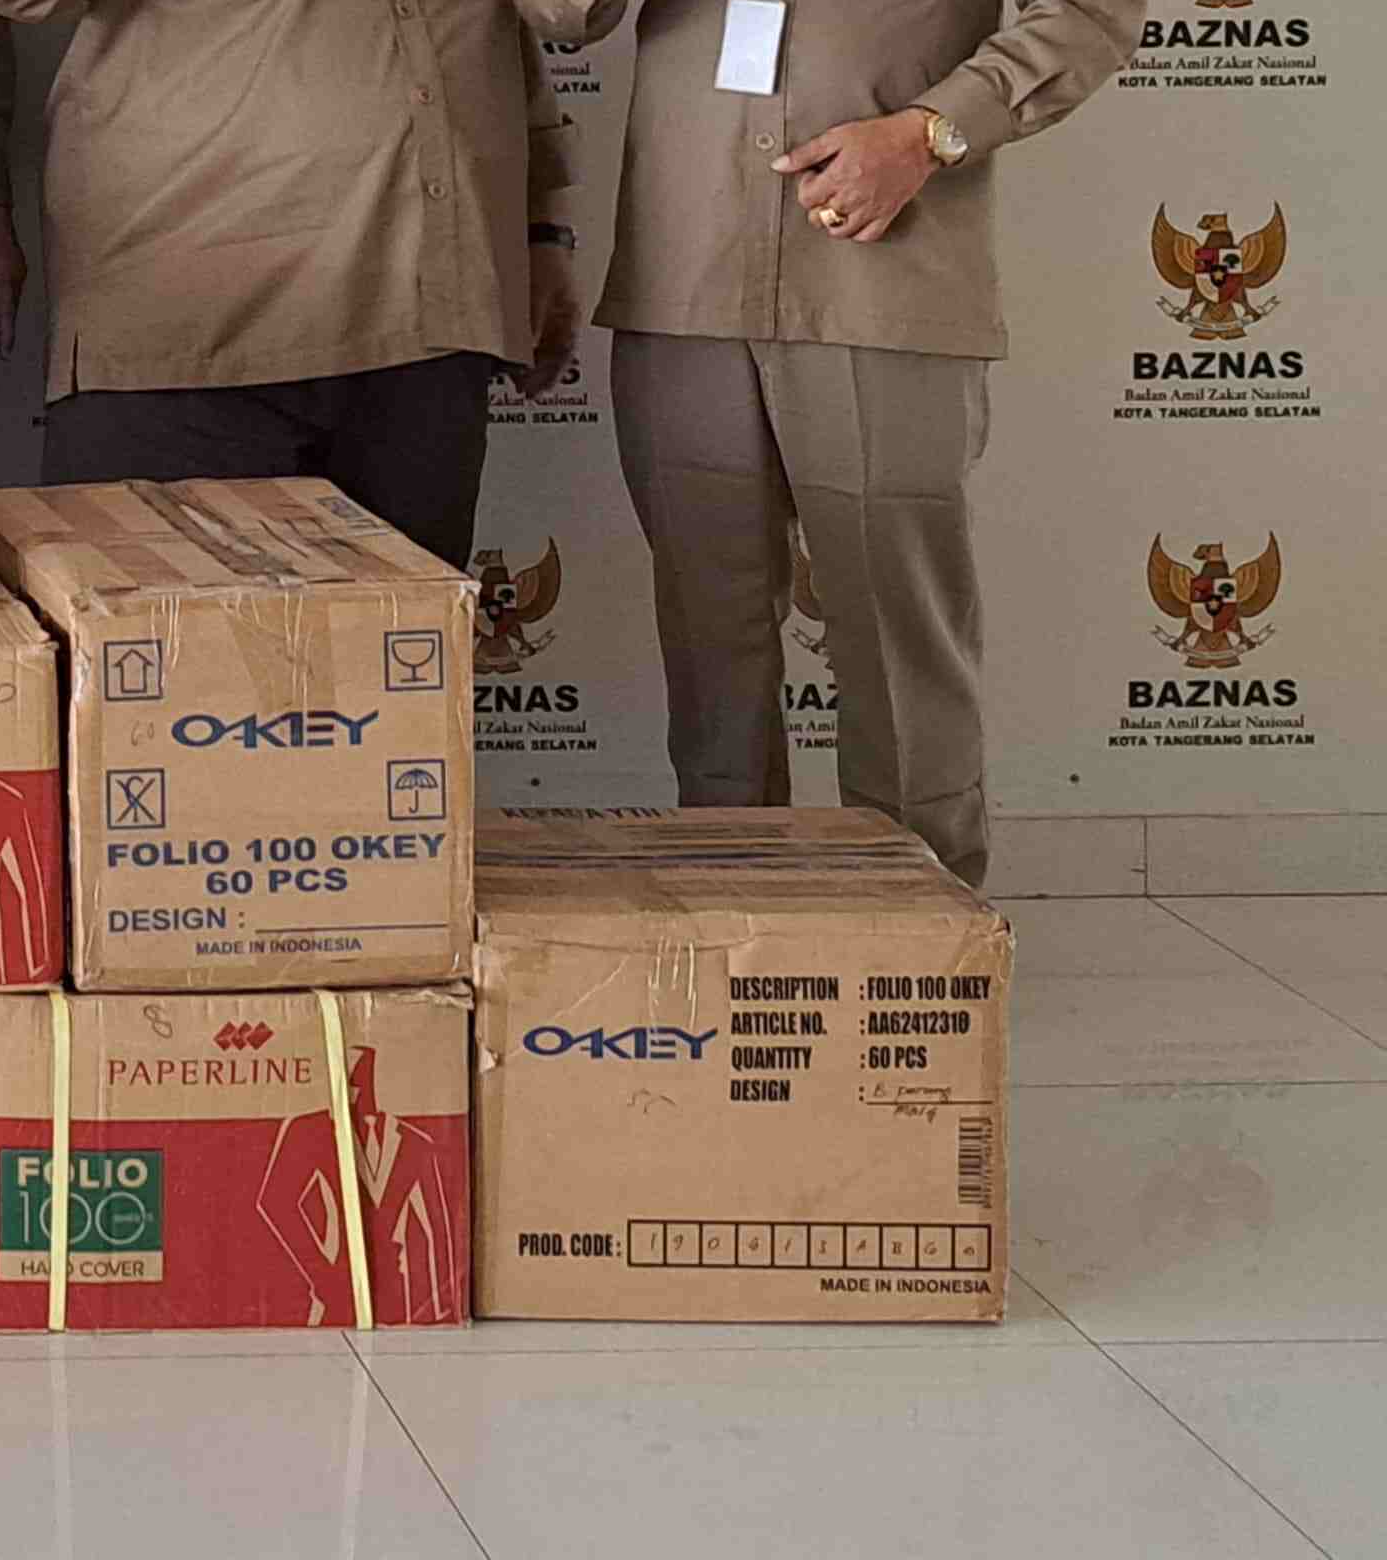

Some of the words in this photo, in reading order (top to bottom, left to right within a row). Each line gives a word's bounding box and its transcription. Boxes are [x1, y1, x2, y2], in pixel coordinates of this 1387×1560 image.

[1133, 351, 1303, 379] BAZNAS
[1125, 389, 1166, 401] Badan
[1171, 389, 1204, 400] Amil
[1208, 389, 1246, 400] Zakat
[1251, 387, 1310, 399] Nasional
[1114, 408, 1154, 419] KOTA
[1159, 407, 1248, 418] TANGERANG
[1255, 406, 1321, 417] SELATAN
[107, 839, 229, 867] FOLIO
[245, 837, 316, 864] 100
[331, 832, 447, 861] OKEY
[206, 870, 253, 895] 60
[269, 866, 348, 893] PCS
[108, 907, 226, 933] DESIGN
[196, 939, 245, 955] MADE
[249, 939, 265, 954] IN
[270, 936, 362, 953] INDONESIA
[730, 976, 839, 1001] DESCRIPTION
[916, 975, 947, 999] 100
[950, 975, 991, 999] OKEY
[731, 1011, 796, 1035] ARTICLE
[800, 1011, 828, 1035] NO.
[107, 1056, 313, 1086] PAPERLINE
[731, 1046, 812, 1072] QUANTITY
[894, 1045, 928, 1069] PCS
[730, 1080, 790, 1102] DESIGN
[20, 1191, 146, 1246] 100
[518, 1233, 566, 1258] PROD.
[80, 1260, 144, 1277] COVER
[820, 1277, 870, 1293] MADE
[875, 1278, 891, 1293] IN
[896, 1279, 992, 1295] INDONESIA
